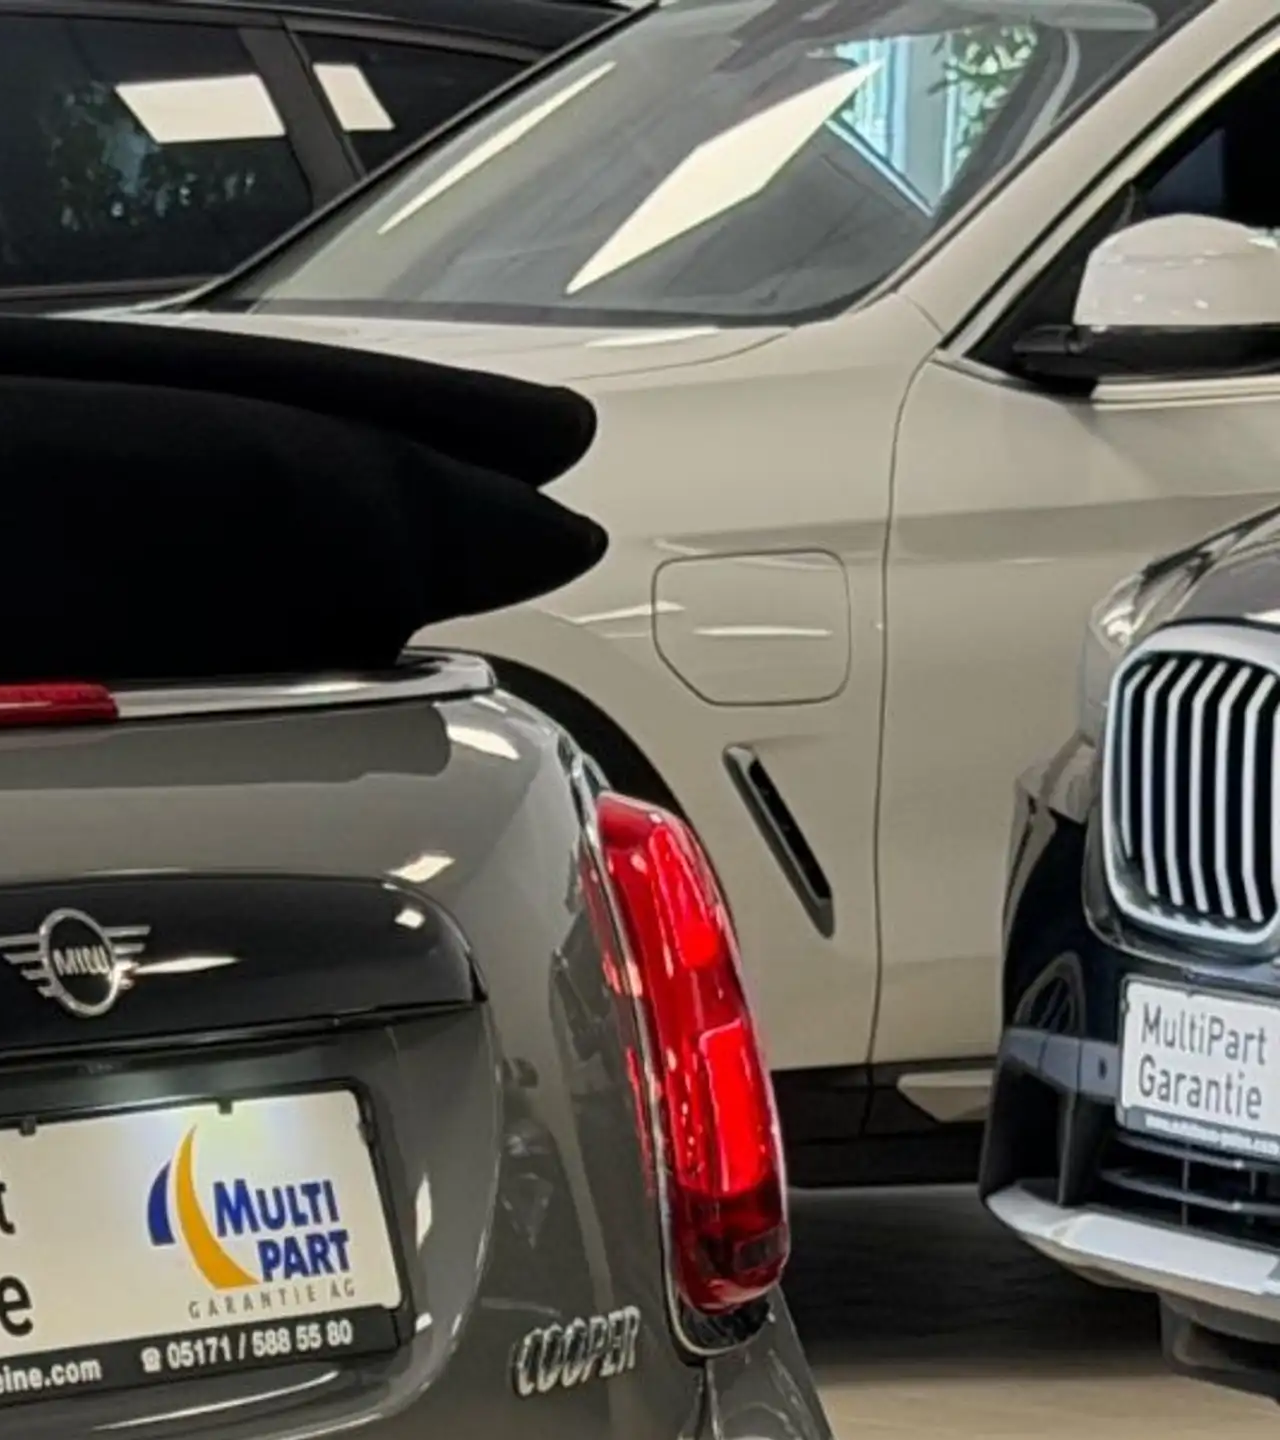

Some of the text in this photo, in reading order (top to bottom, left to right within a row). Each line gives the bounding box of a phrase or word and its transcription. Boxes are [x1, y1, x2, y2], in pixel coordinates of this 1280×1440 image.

[53, 944, 111, 976] MINI
[1142, 1003, 1268, 1065] MultiPart
[1139, 1053, 1262, 1120] Garantie
[212, 1177, 339, 1238] MULTI
[256, 1229, 350, 1282] PART
[188, 1278, 356, 1320] GARANTIE AG
[166, 1334, 233, 1371] 05171
[252, 1327, 291, 1358] 588
[296, 1322, 322, 1351] 55
[327, 1318, 353, 1347] 80
[517, 1305, 640, 1397] COOPER
